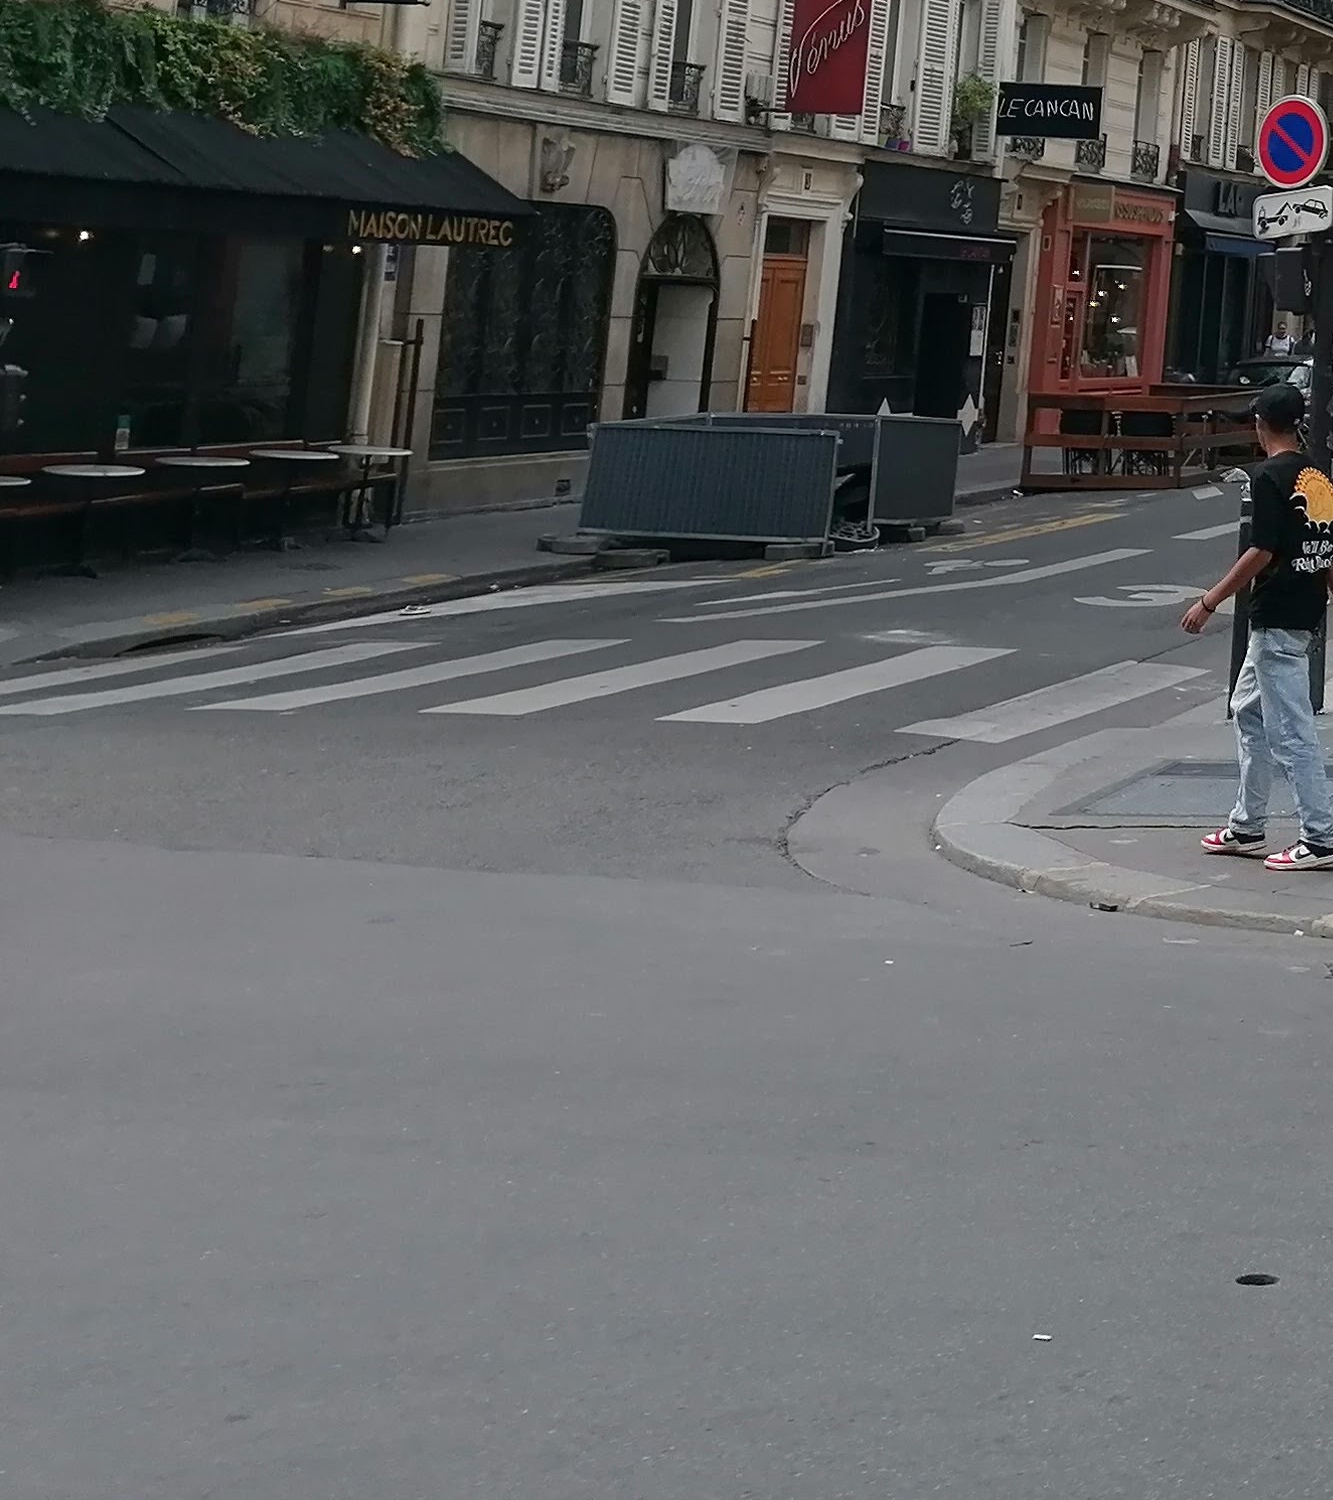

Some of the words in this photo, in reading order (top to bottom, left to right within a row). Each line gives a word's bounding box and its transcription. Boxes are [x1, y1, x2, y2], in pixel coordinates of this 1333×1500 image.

[998, 98, 1024, 118] LE
[1024, 99, 1094, 121] CANCAN
[348, 209, 422, 239] MAISON
[425, 214, 514, 247] LAUTREC
